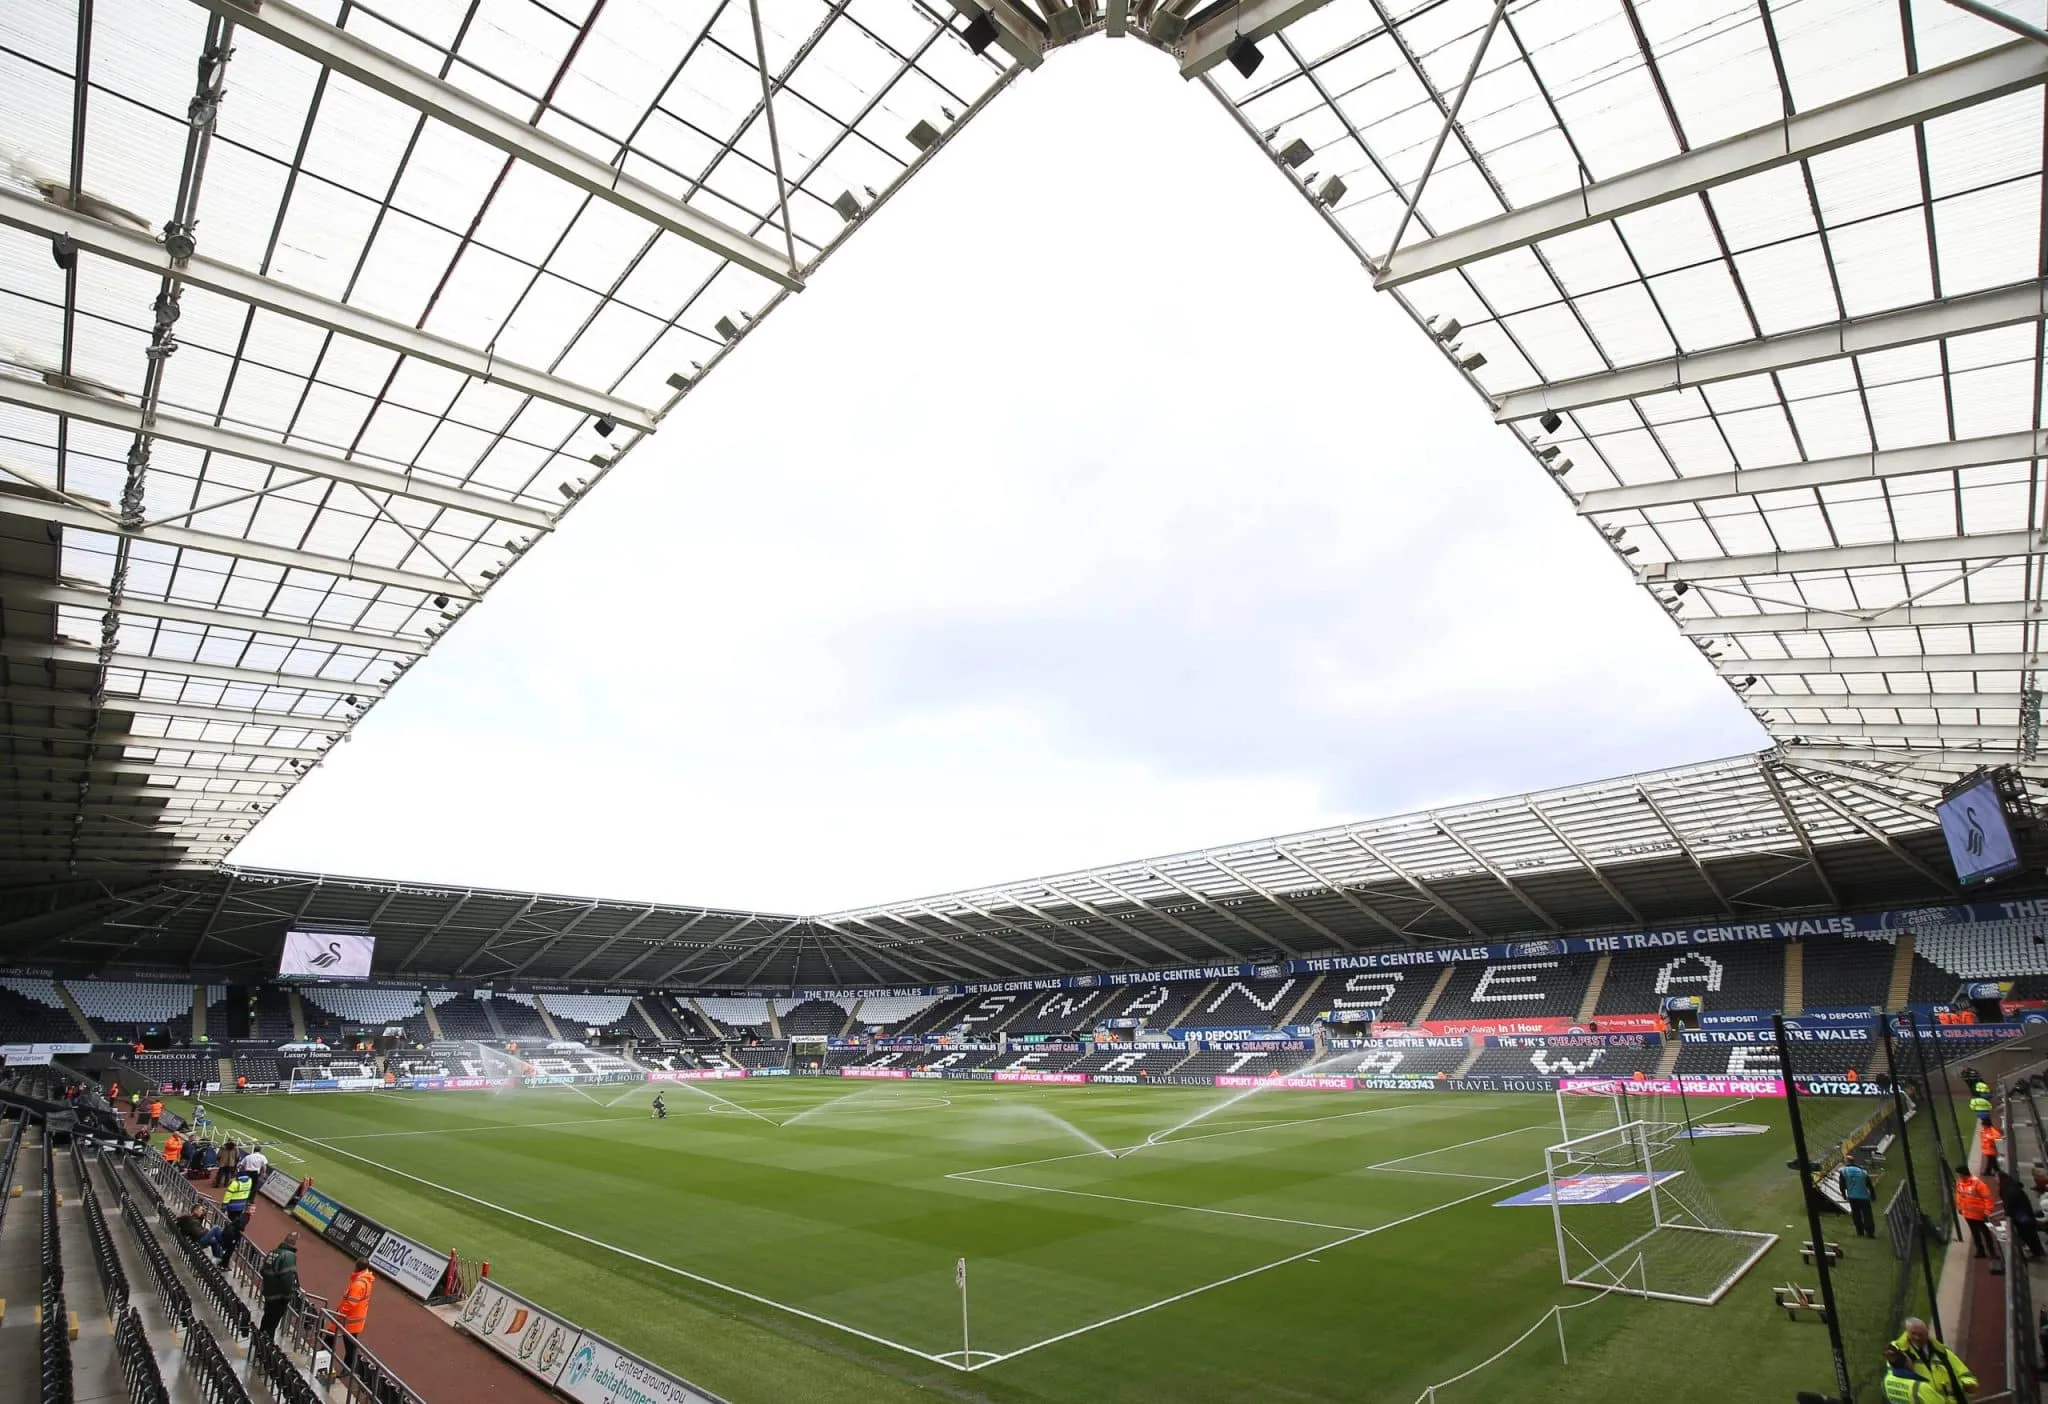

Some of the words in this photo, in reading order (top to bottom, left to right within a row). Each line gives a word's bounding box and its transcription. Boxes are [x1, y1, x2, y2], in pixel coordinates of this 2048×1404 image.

[1908, 913, 1946, 925] CENTRE
[1586, 937, 1620, 951] THE
[1623, 931, 1688, 948] TRADE
[1693, 924, 1773, 943] CENTRE
[1776, 917, 1855, 937] WALES
[1307, 959, 1330, 972] THE
[1333, 956, 1377, 968] TRADE
[1380, 952, 1434, 966] CENTRE
[1437, 947, 1489, 961] WALES
[1110, 975, 1127, 985] THE
[1129, 972, 1161, 983] TRADE
[1163, 969, 1201, 981] CENTRE
[1203, 966, 1240, 978] WALES
[965, 985, 978, 993] THE
[979, 984, 1003, 993] TRADE
[1004, 982, 1033, 991] CENTRE
[1034, 979, 1061, 989] WALES
[804, 990, 821, 998] THE
[824, 990, 855, 998] TRADE
[857, 989, 892, 997] CENTRE
[893, 988, 922, 996] WALES
[1471, 1024, 1496, 1035] Away
[1499, 1024, 1508, 1033] In
[1510, 1024, 1516, 1033] 1
[1518, 1023, 1543, 1033] Hour
[1185, 1031, 1204, 1041] £99
[1498, 1037, 1518, 1047] THE
[1547, 1035, 1606, 1046] CHEAPEST
[1609, 1034, 1644, 1046] CARS
[1683, 1032, 1707, 1043] THE
[1710, 1031, 1756, 1042] TRADE
[1758, 1030, 1813, 1042] CETRE
[1816, 1029, 1867, 1040] WALES
[1134, 1042, 1161, 1050] CENTRE
[1162, 1042, 1185, 1050] WALES
[1223, 1042, 1240, 1050] UK'S
[1331, 1040, 1348, 1048] THE
[1386, 1039, 1422, 1048] CENTRE
[1423, 1038, 1463, 1047] WALES
[284, 1052, 307, 1060] Luxury
[618, 1072, 645, 1081] HOUSE
[1146, 1076, 1178, 1085] TRAVEL
[1180, 1076, 1212, 1085] HOUSE
[457, 1079, 484, 1087] GREAT
[1220, 1077, 1251, 1086] EXPERT
[1287, 1078, 1321, 1087] GREAT
[1324, 1079, 1347, 1088] PRICE
[1366, 1079, 1399, 1089] 01792
[1399, 1080, 1434, 1089] 293743
[1448, 1080, 1498, 1091] TRAVEL
[1503, 1080, 1553, 1091] HOUSE
[1567, 1081, 1618, 1093] EXPERT
[1678, 1082, 1722, 1093] GREAT
[1726, 1081, 1777, 1093] PRICE
[1809, 1083, 1861, 1094] 01792
[614, 1356, 643, 1380] Centred
[642, 1373, 670, 1395] around
[668, 1387, 686, 1404] you
